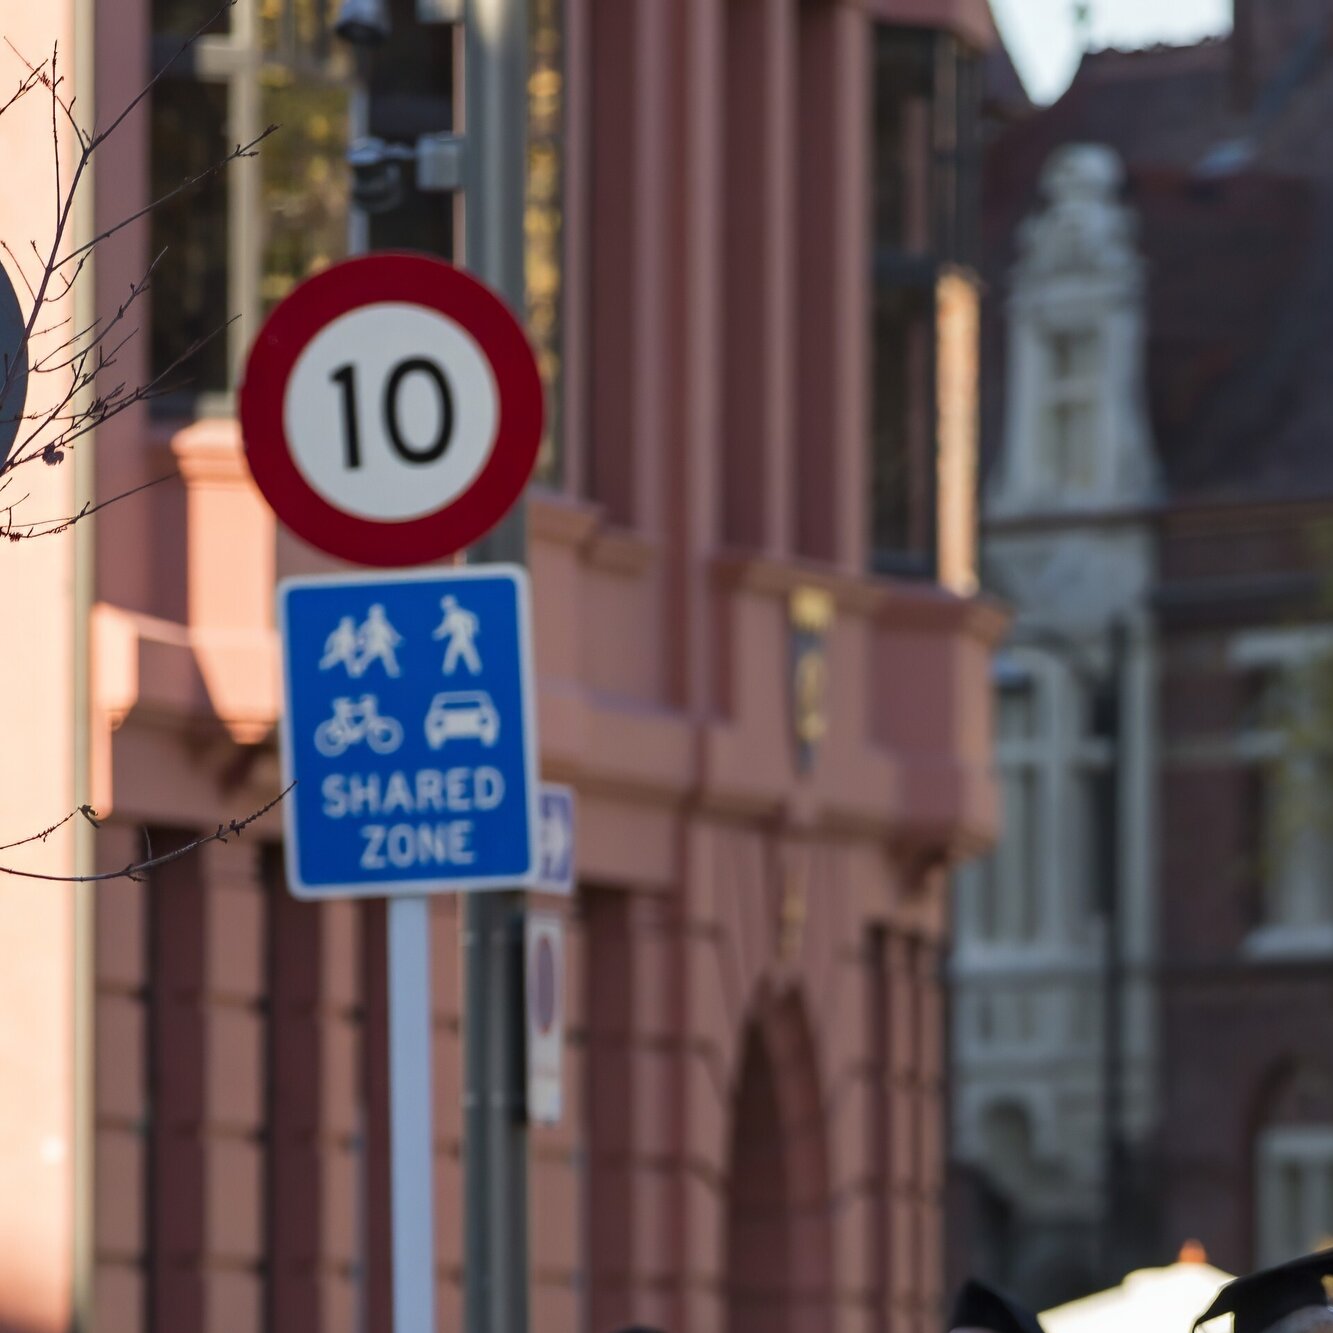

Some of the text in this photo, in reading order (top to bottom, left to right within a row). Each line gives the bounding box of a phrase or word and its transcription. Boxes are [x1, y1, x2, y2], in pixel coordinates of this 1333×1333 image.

[329, 356, 456, 470] 10
[321, 765, 507, 820] SHARED
[359, 819, 478, 871] ZONE
